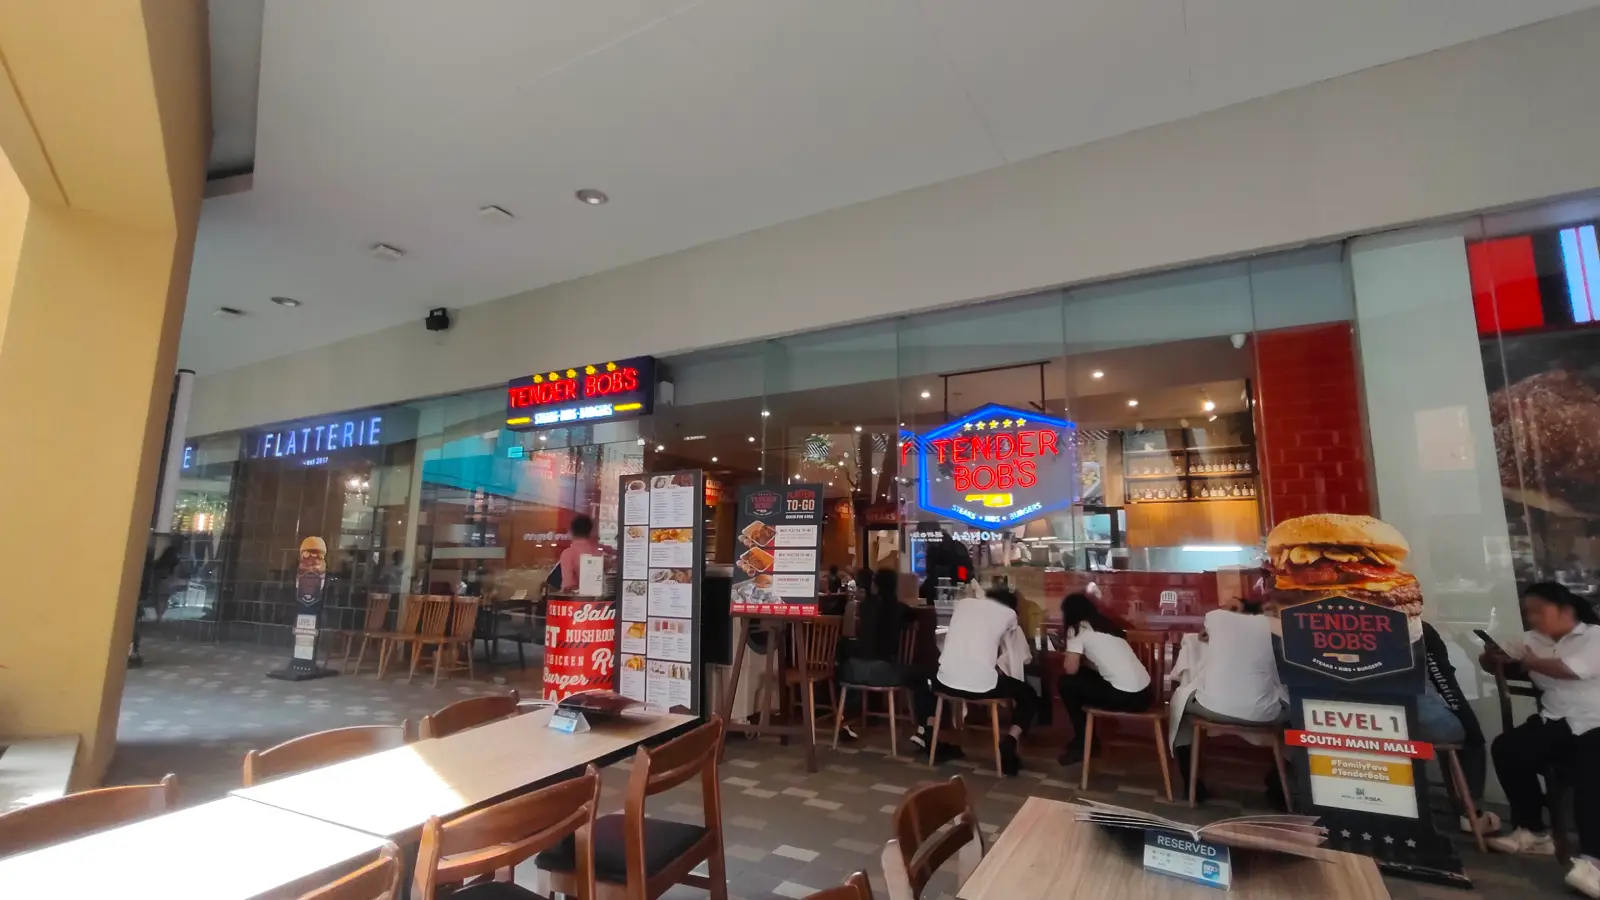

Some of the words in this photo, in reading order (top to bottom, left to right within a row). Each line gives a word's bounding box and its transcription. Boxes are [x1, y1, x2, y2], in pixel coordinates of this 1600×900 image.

[509, 378, 577, 408] TENDER
[584, 367, 639, 397] BOB'S
[263, 417, 382, 459] FLATTERIE
[932, 429, 1059, 464] TENDER
[954, 460, 1037, 491] BOB'S
[951, 504, 976, 520] STEAKS
[1293, 612, 1393, 633] TENDER
[1312, 631, 1378, 651] BOB'S
[542, 666, 589, 690] Burger
[1311, 709, 1383, 732] LEVEL
[1389, 716, 1400, 733] 1
[1299, 733, 1343, 748] SOUTH
[1344, 737, 1380, 751] MAIN
[1383, 741, 1418, 755] MALL
[1157, 835, 1217, 857] RESERVED
